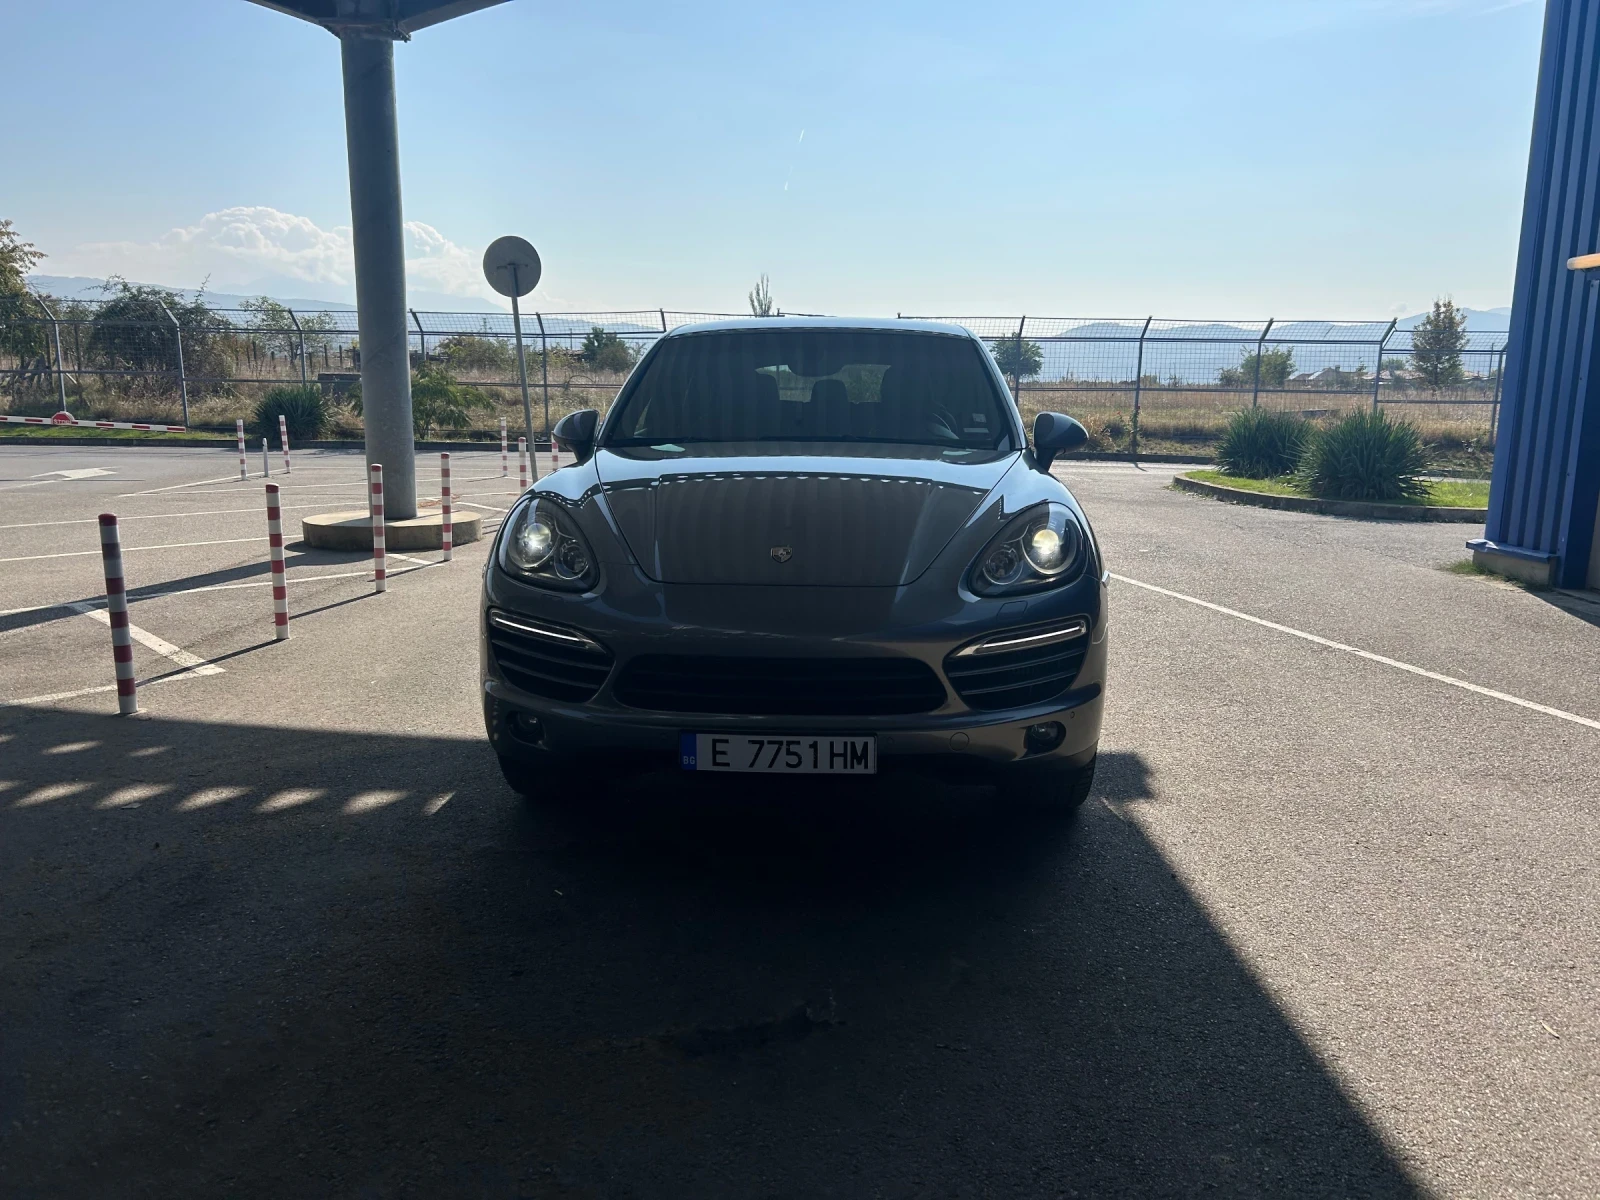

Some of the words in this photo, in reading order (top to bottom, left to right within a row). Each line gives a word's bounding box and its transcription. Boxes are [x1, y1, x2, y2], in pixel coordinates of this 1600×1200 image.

[683, 755, 696, 765] BG
[711, 738, 731, 768] E
[747, 739, 819, 769] 7751
[829, 740, 869, 770] HM
